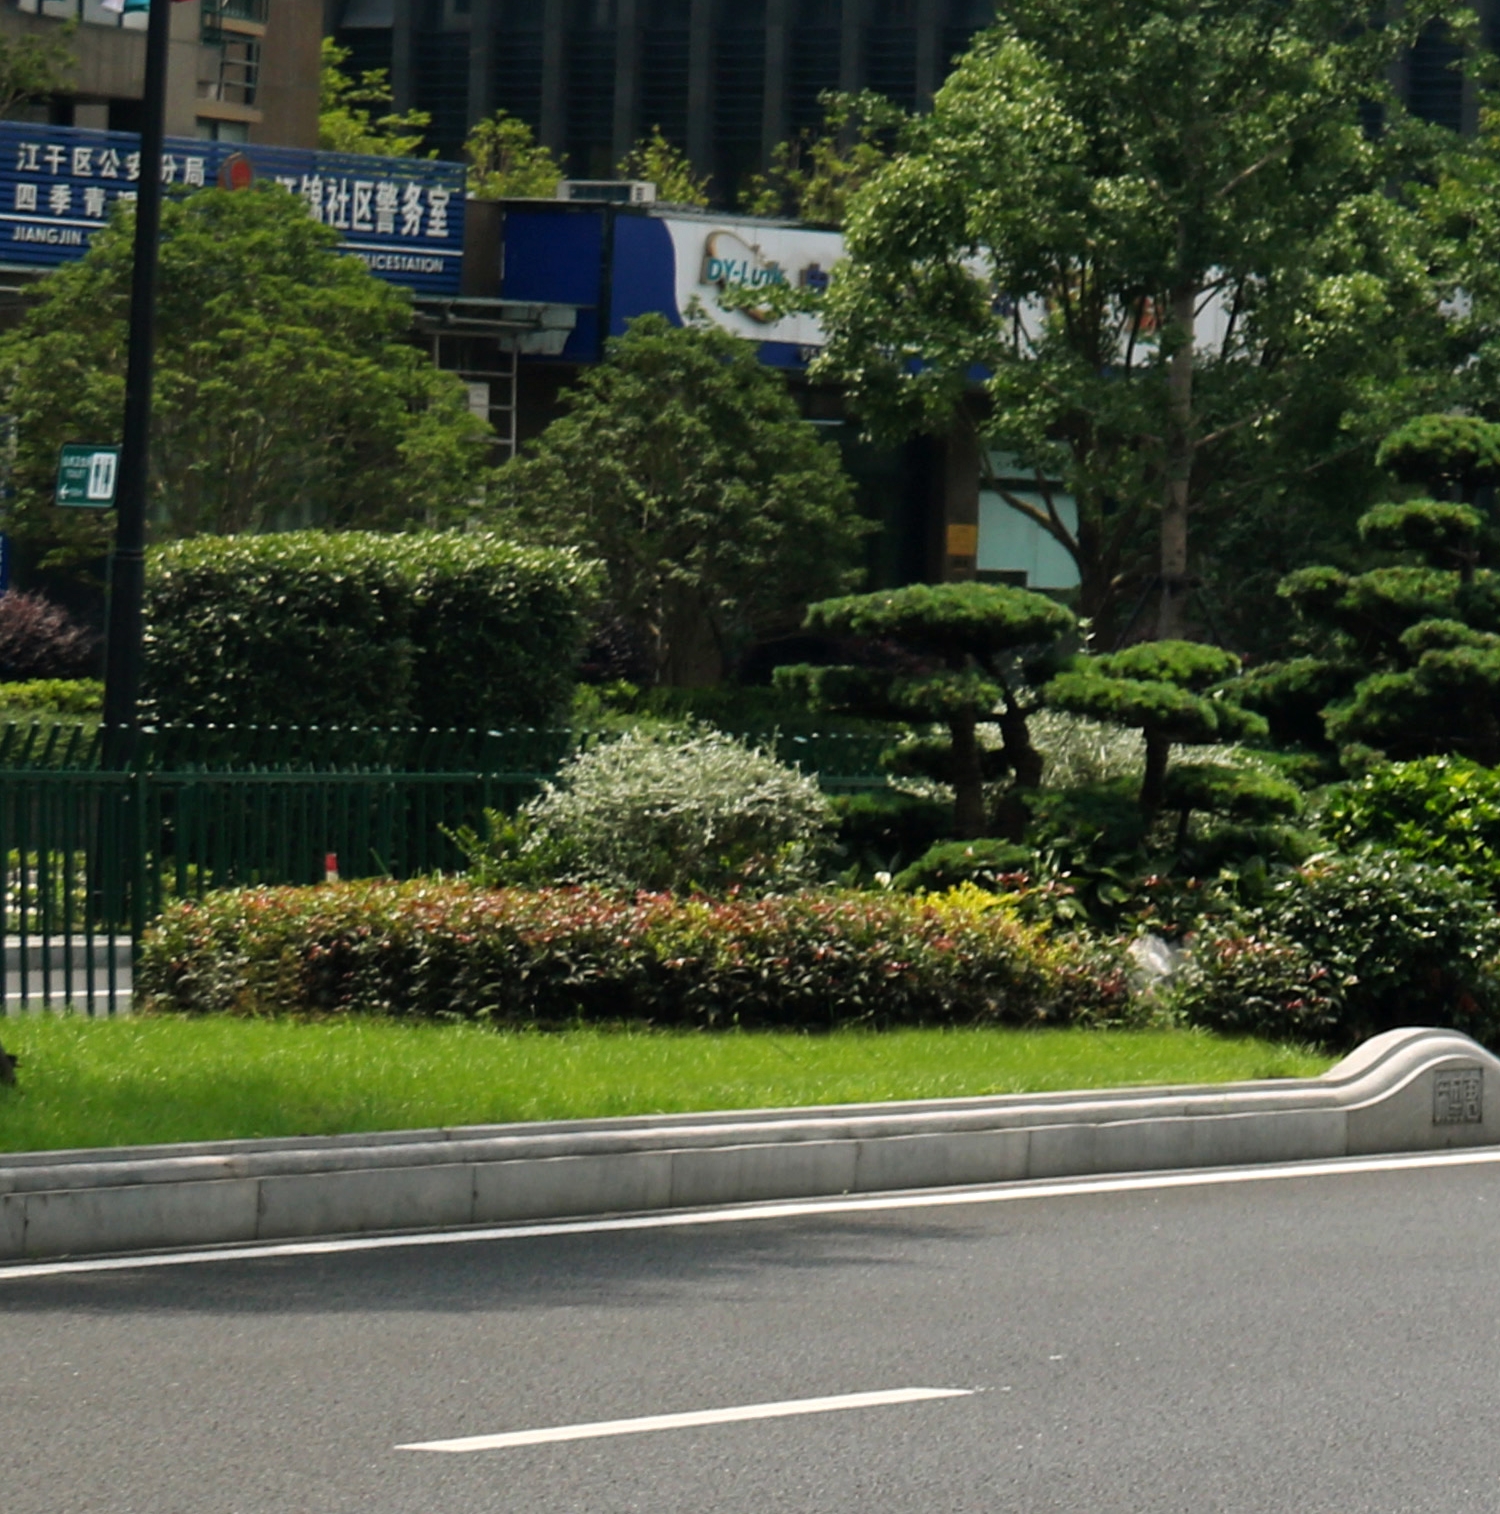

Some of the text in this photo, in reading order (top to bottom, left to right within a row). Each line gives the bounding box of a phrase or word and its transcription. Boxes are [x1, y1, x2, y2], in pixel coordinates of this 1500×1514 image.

[16, 142, 206, 187] 江干区公安分局
[12, 226, 82, 245] JIANGJIN
